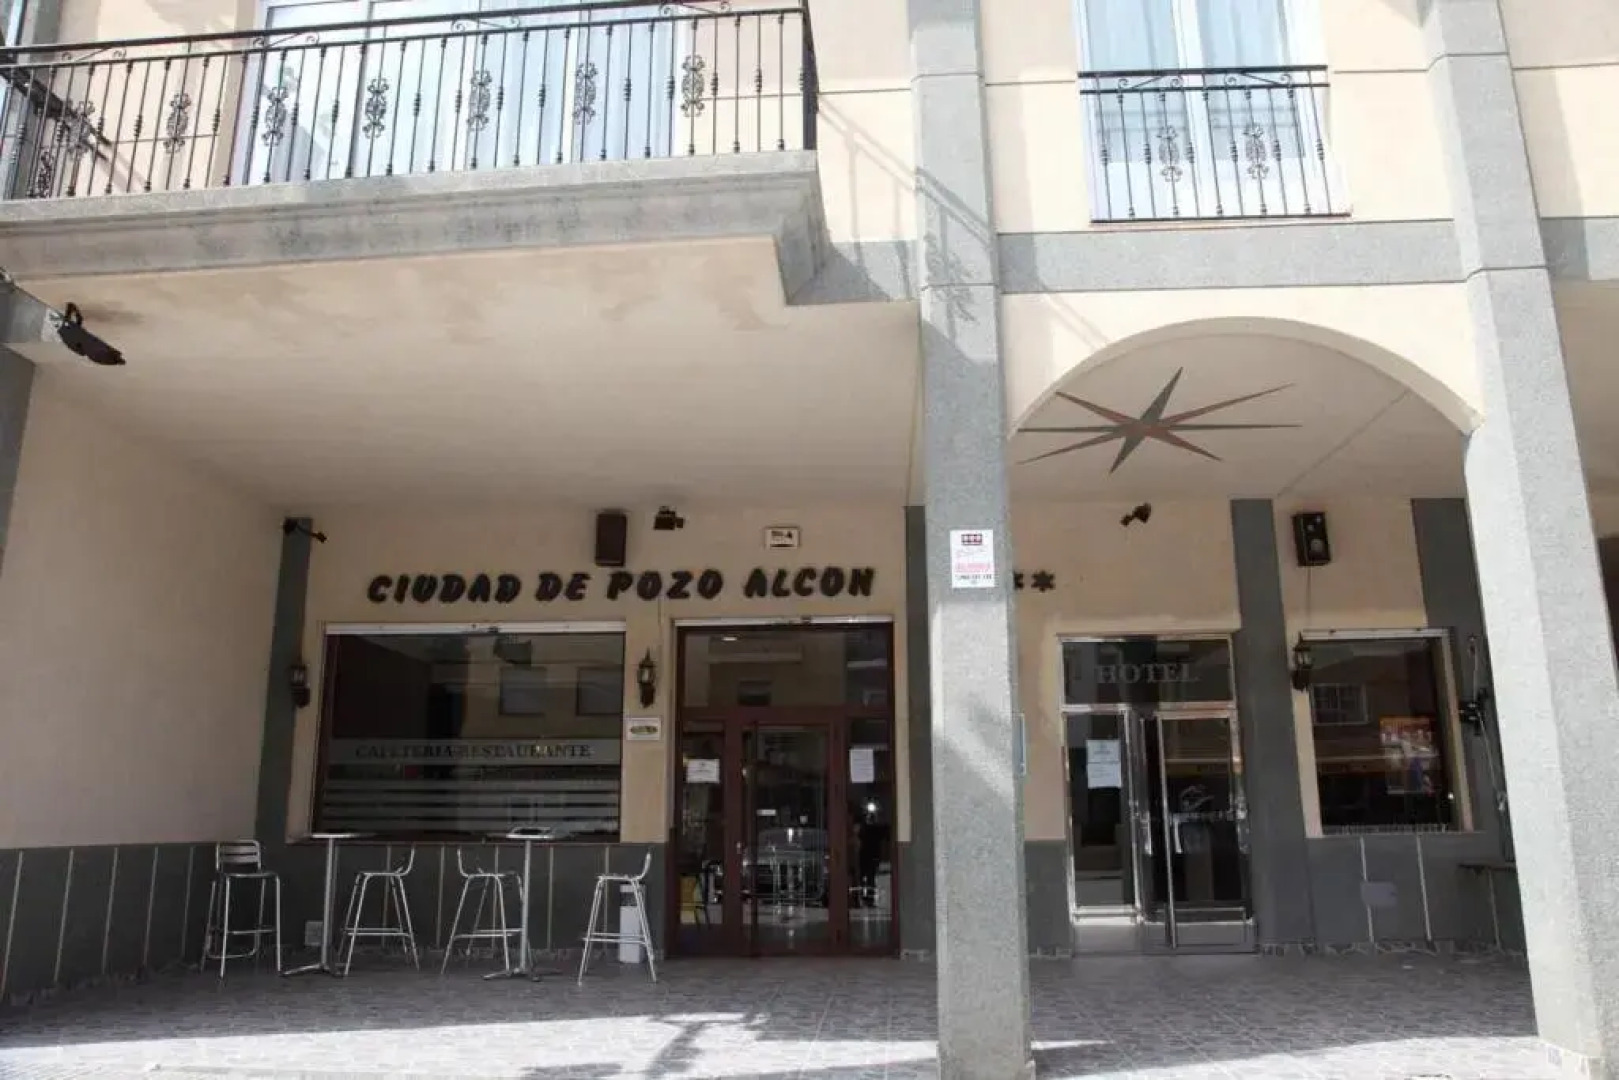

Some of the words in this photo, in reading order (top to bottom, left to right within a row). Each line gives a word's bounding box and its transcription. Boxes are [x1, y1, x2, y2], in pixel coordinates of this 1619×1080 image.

[367, 572, 522, 603] CIUDAD
[534, 572, 590, 602] DE
[606, 569, 725, 602] POZO
[743, 566, 876, 599] ALCON
[1096, 662, 1201, 684] HOTEL
